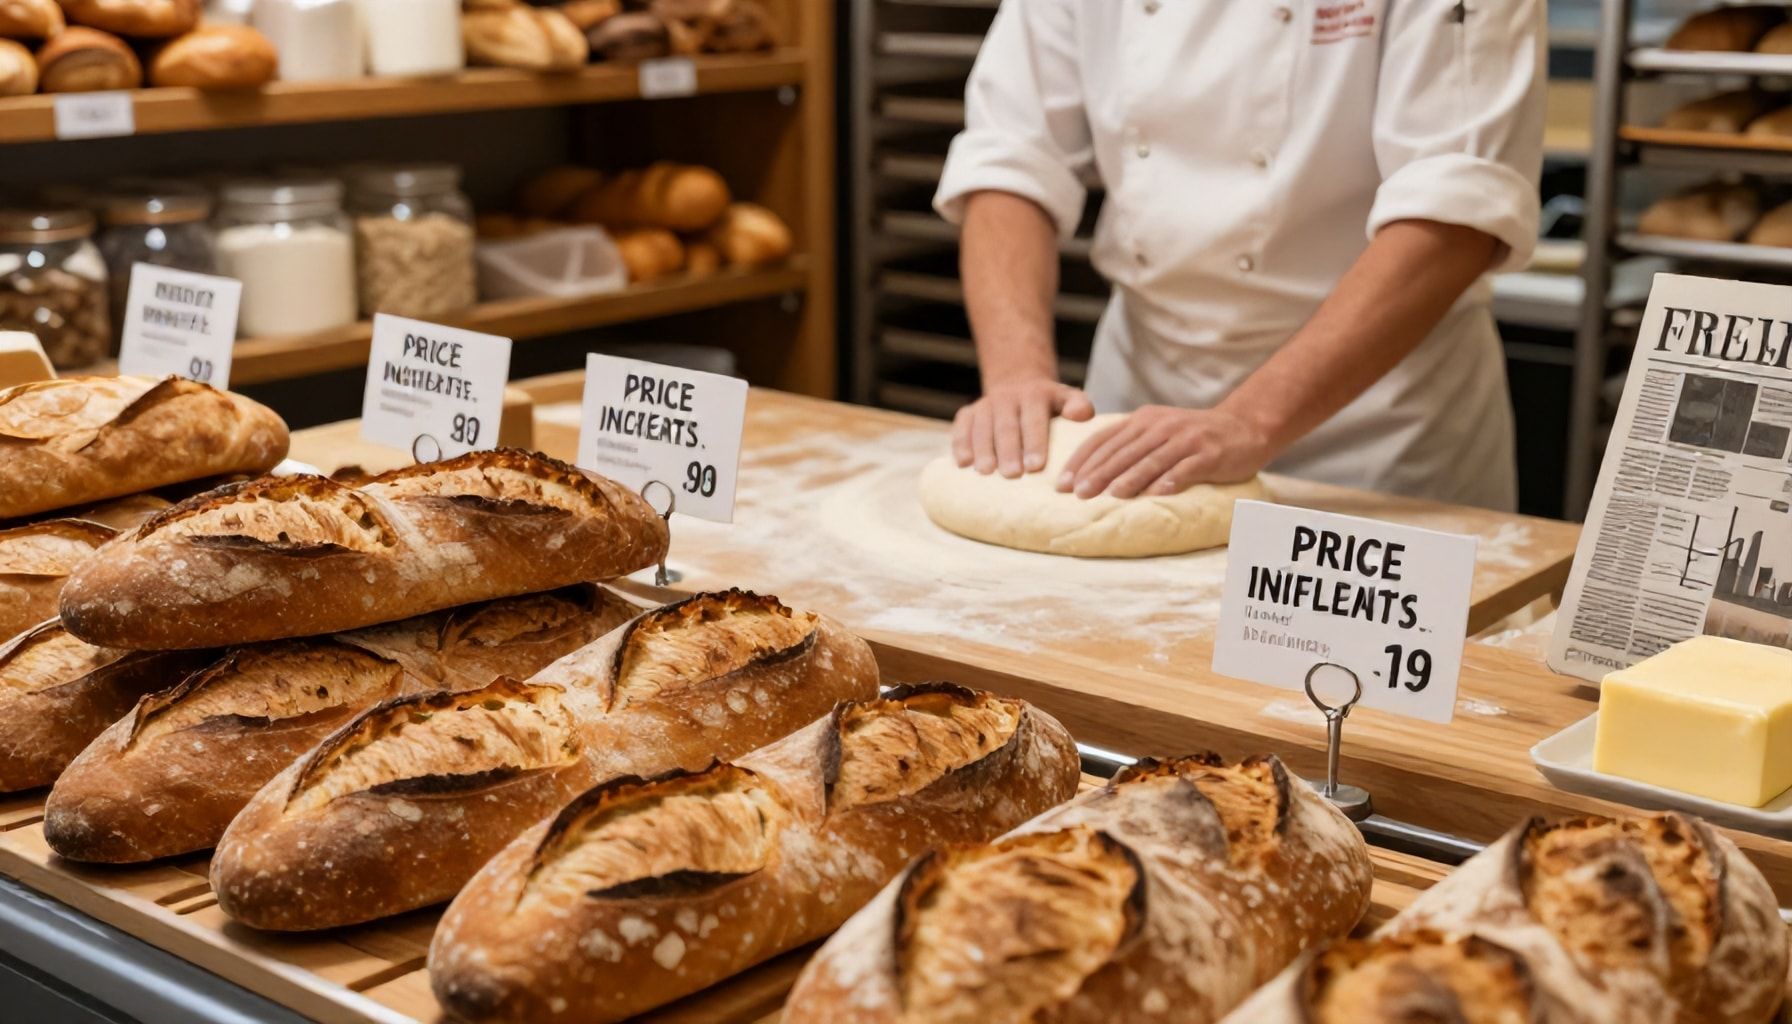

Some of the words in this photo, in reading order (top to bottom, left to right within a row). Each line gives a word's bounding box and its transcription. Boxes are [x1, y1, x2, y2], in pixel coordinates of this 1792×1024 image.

[403, 333, 464, 368] PRICE
[624, 374, 696, 412] PRICE
[1291, 525, 1406, 581] PRICE
